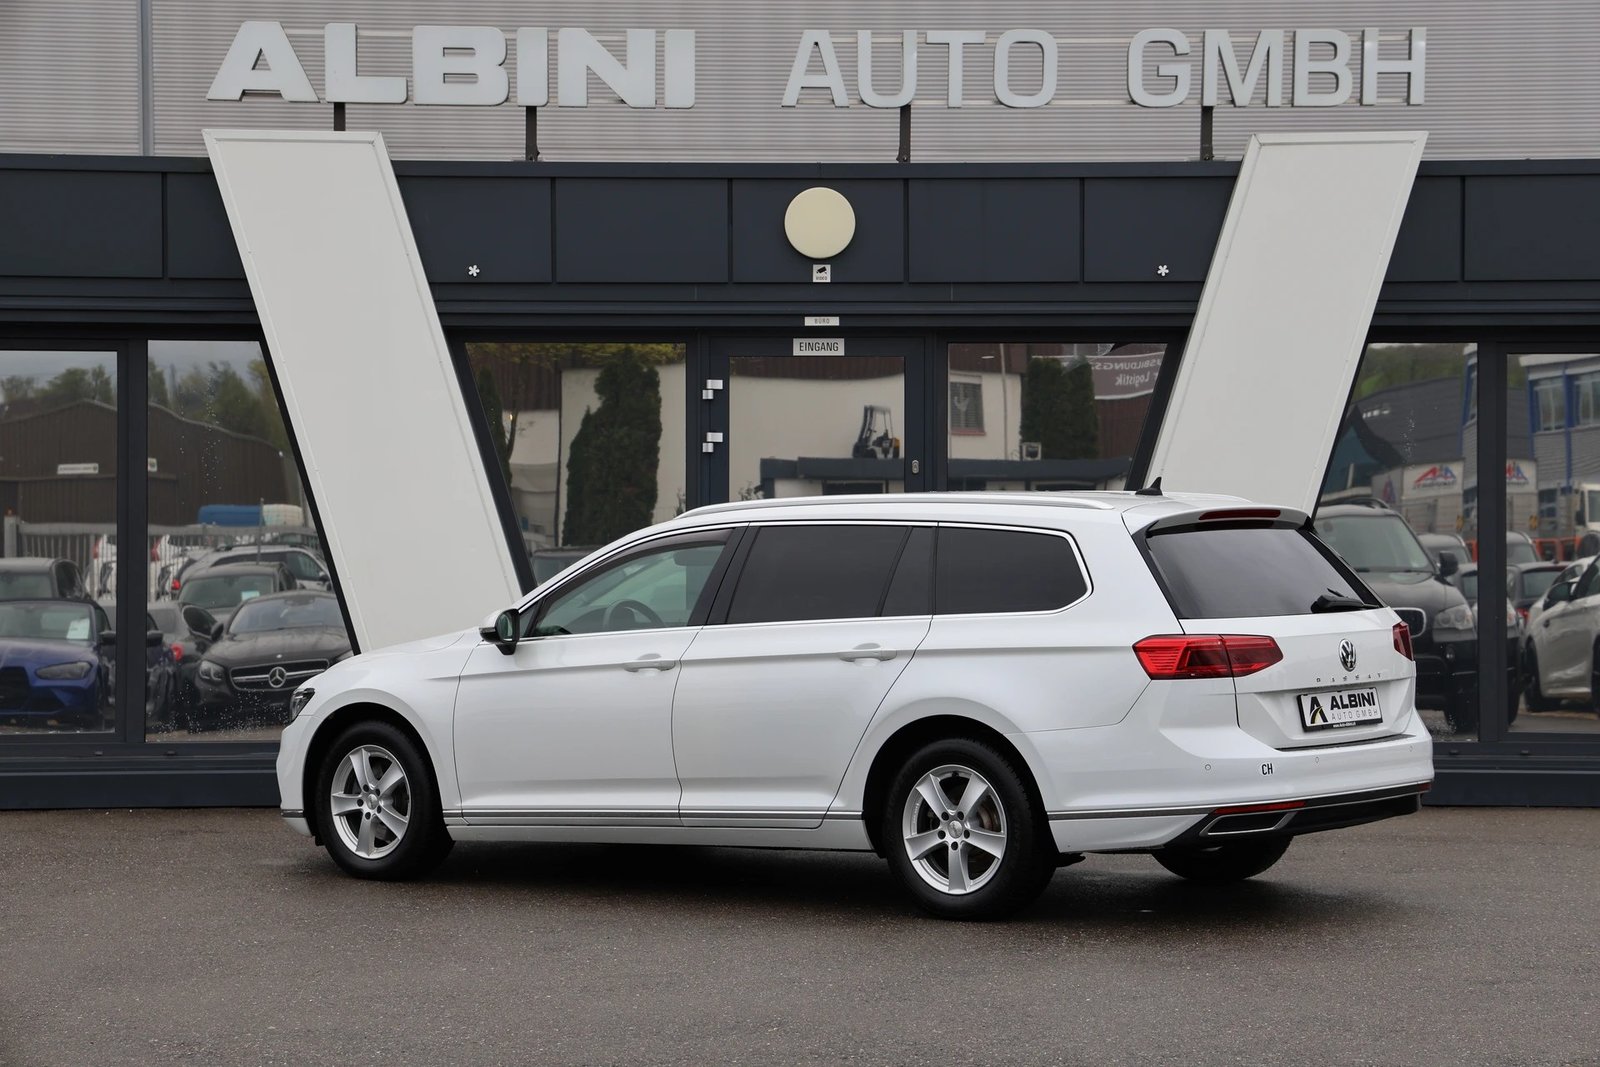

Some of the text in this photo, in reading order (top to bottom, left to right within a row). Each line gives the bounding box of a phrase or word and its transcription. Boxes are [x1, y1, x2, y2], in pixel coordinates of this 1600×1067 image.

[205, 20, 1427, 109] ALBINI AUTO GMBH
[799, 341, 839, 352] EINGANG
[1330, 691, 1376, 710] ALBINI
[1331, 708, 1378, 721] AUTO GMBH
[1261, 763, 1273, 775] CH
